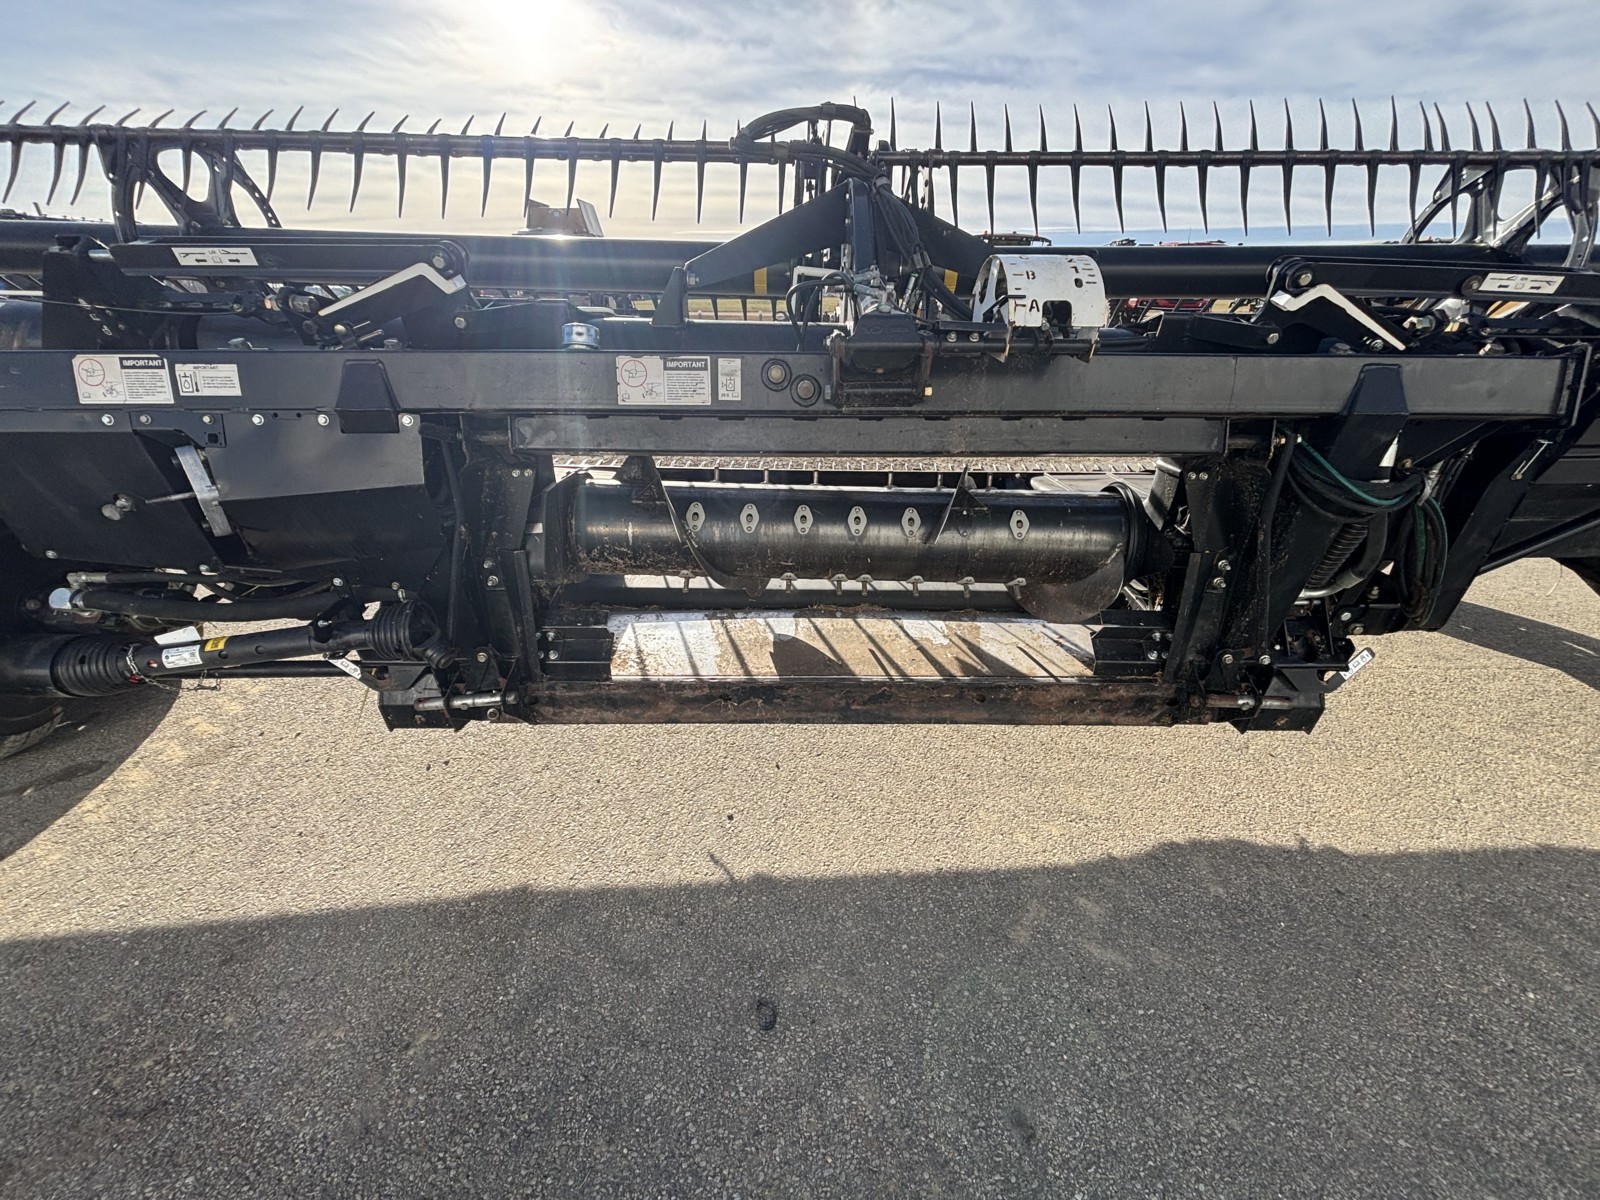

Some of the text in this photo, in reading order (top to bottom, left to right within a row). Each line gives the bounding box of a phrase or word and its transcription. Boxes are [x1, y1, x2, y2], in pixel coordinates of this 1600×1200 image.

[1025, 270, 1036, 280] B
[1029, 299, 1040, 312] A
[122, 359, 162, 367] IMPORTANT
